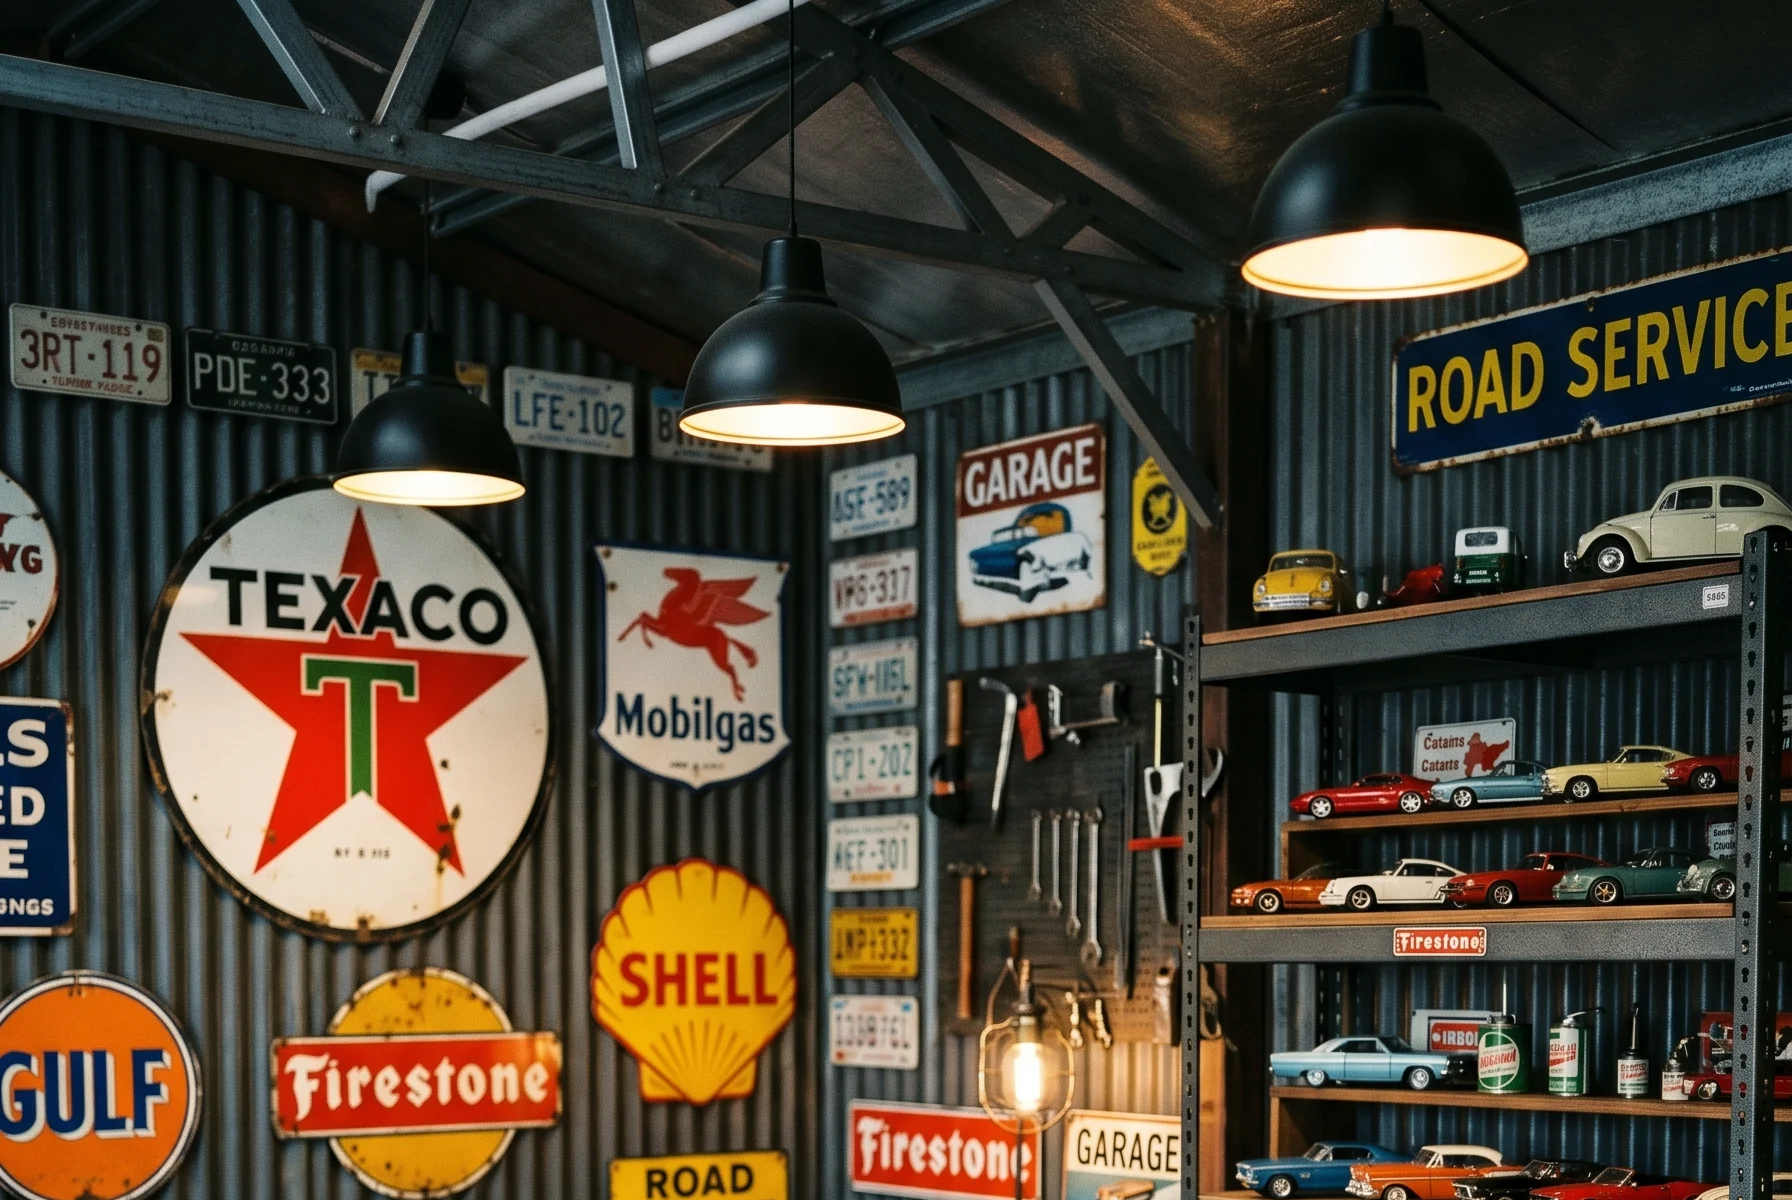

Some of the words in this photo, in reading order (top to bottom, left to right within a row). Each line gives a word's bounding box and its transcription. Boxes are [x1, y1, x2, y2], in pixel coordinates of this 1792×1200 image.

[1408, 341, 1544, 433] ROAD
[1567, 281, 1792, 398] SERVICE
[964, 436, 1096, 508] GARAGE
[209, 566, 510, 646] TEXACO
[0, 718, 49, 767] S
[616, 691, 775, 753] Mobilgas
[1400, 932, 1480, 952] Firestone
[620, 952, 778, 1008] SHELL
[0, 1048, 171, 1143] GULF
[284, 1053, 550, 1121] Firestone
[646, 1163, 754, 1200] ROAD
[856, 1115, 1032, 1184] Firestone
[1077, 1128, 1179, 1173] GARAGE
